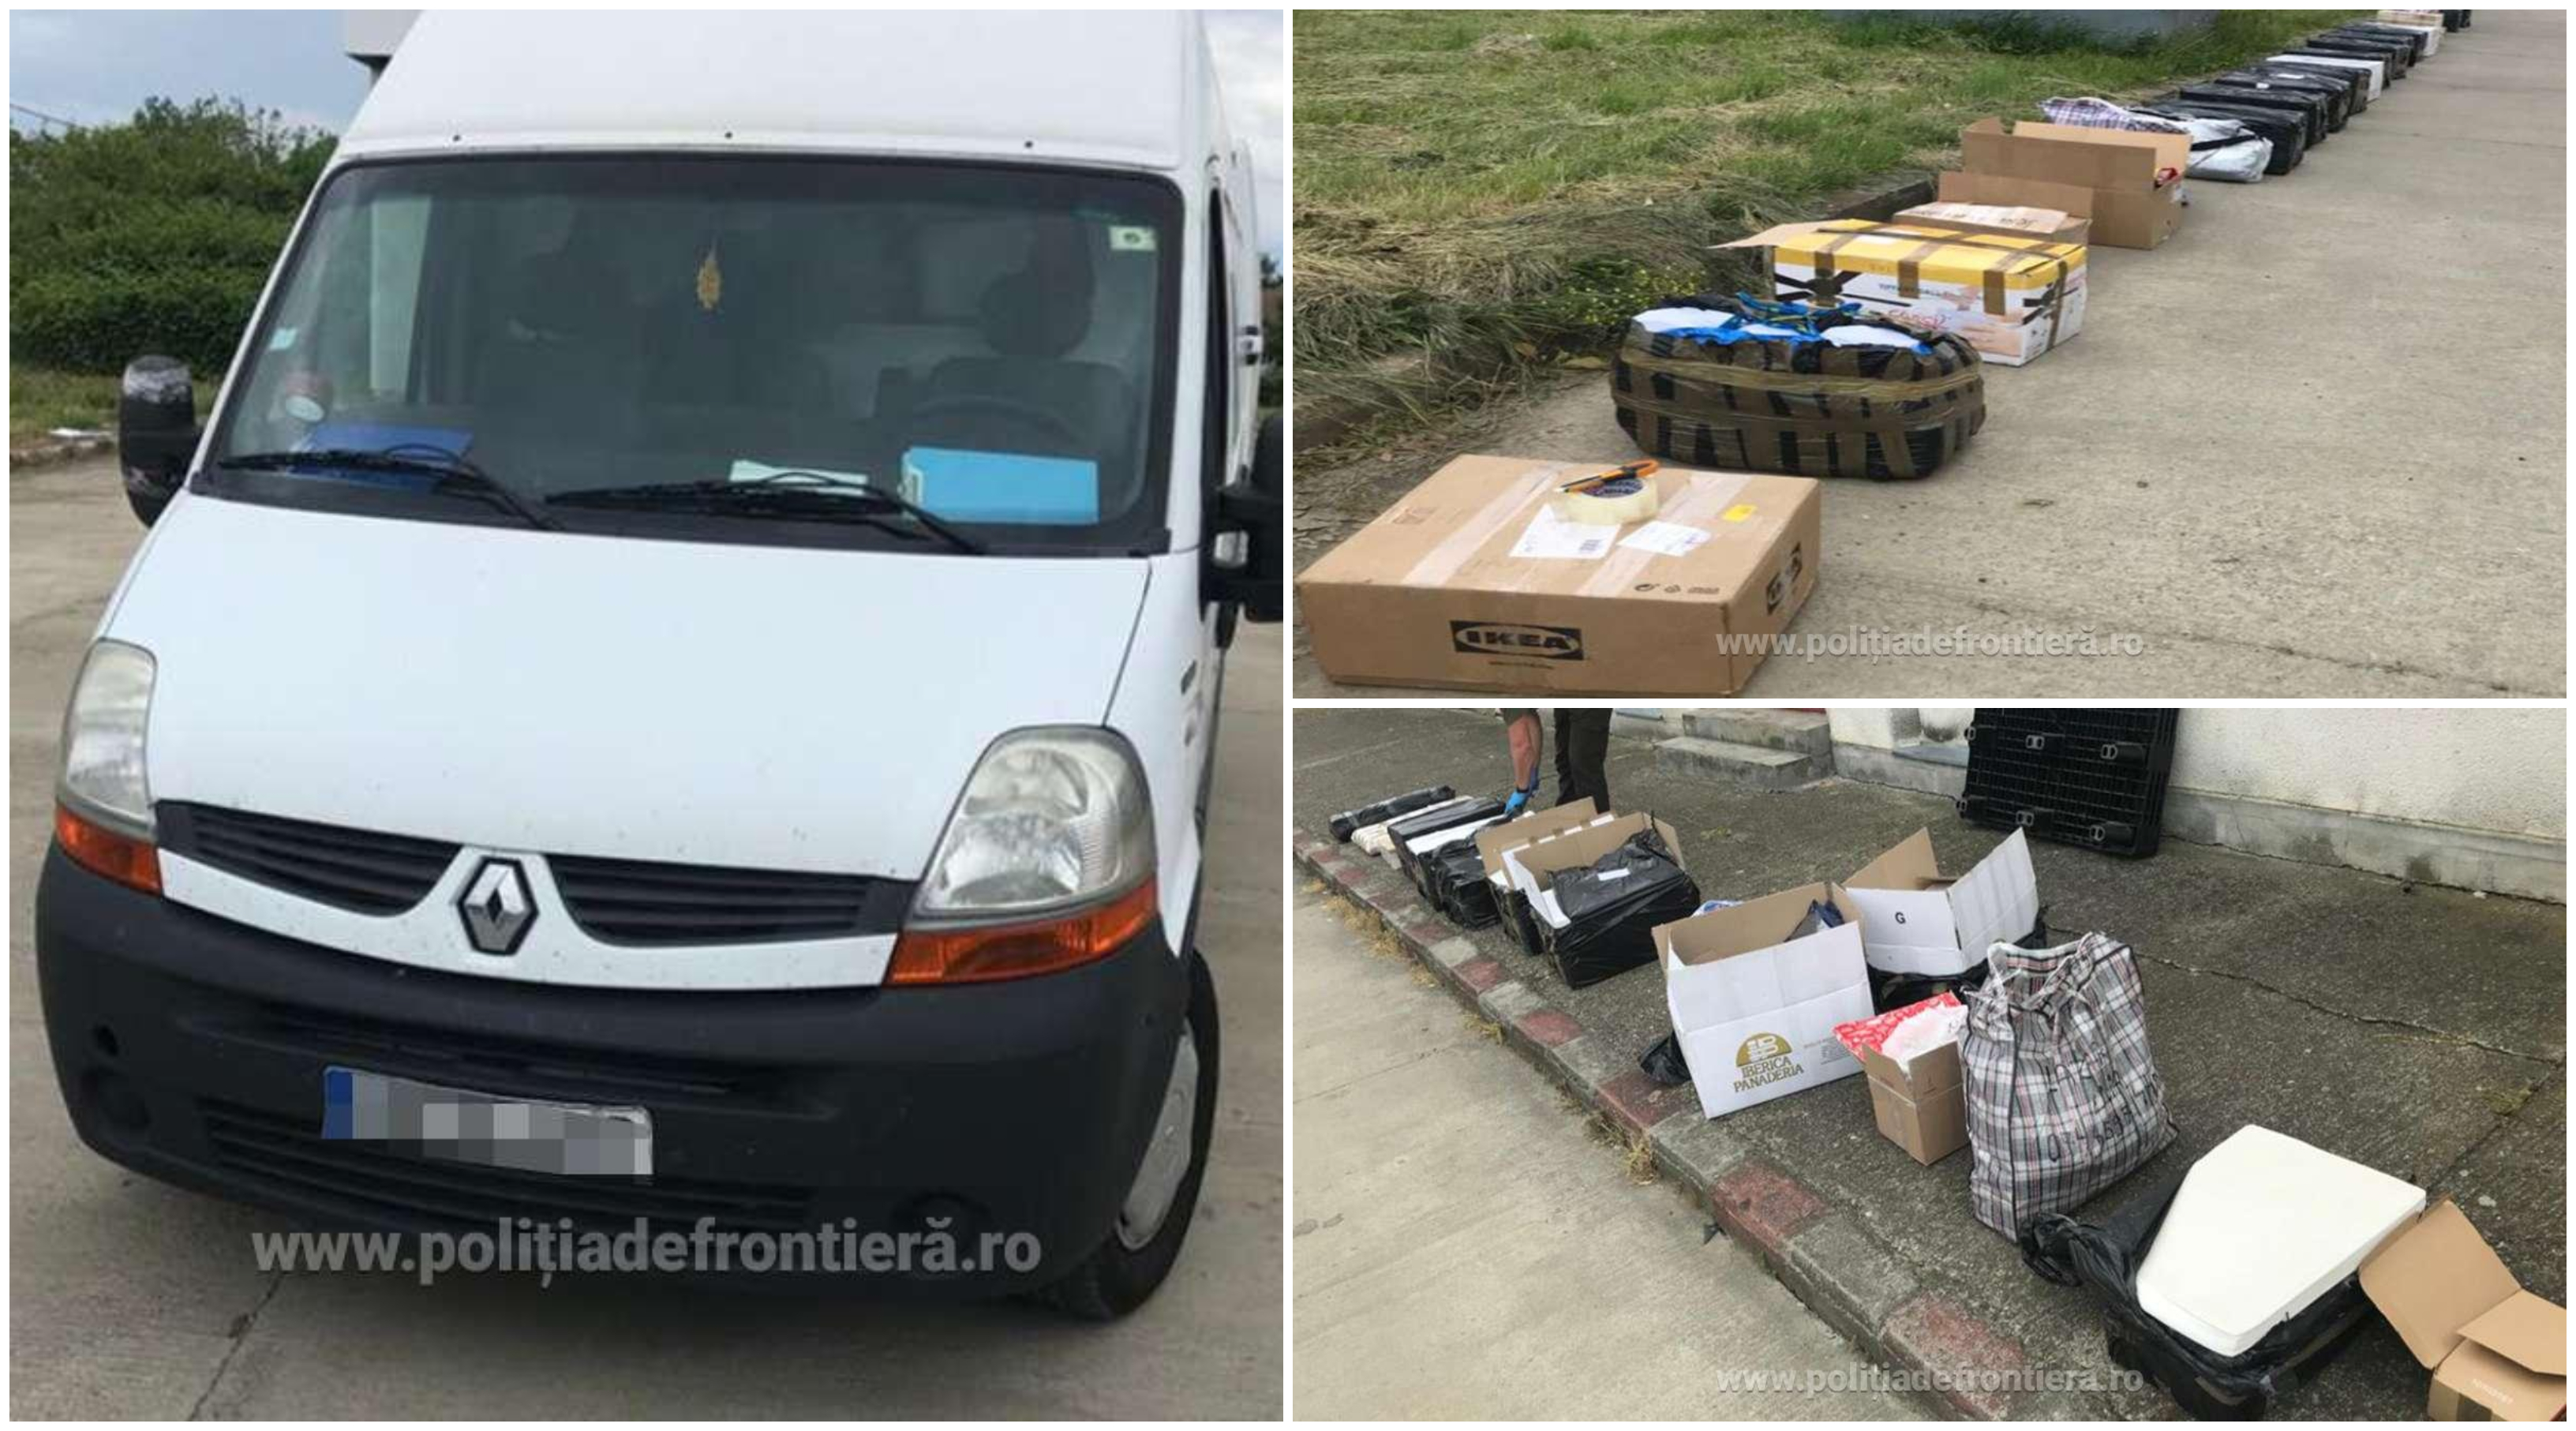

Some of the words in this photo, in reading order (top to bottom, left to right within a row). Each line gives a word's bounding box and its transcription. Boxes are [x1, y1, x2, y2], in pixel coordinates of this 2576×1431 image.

[1466, 630, 1571, 650] IKEA
[1895, 912, 1906, 924] G
[1741, 1055, 1792, 1078] IBERICA
[1733, 1063, 1805, 1093] PANADERIA
